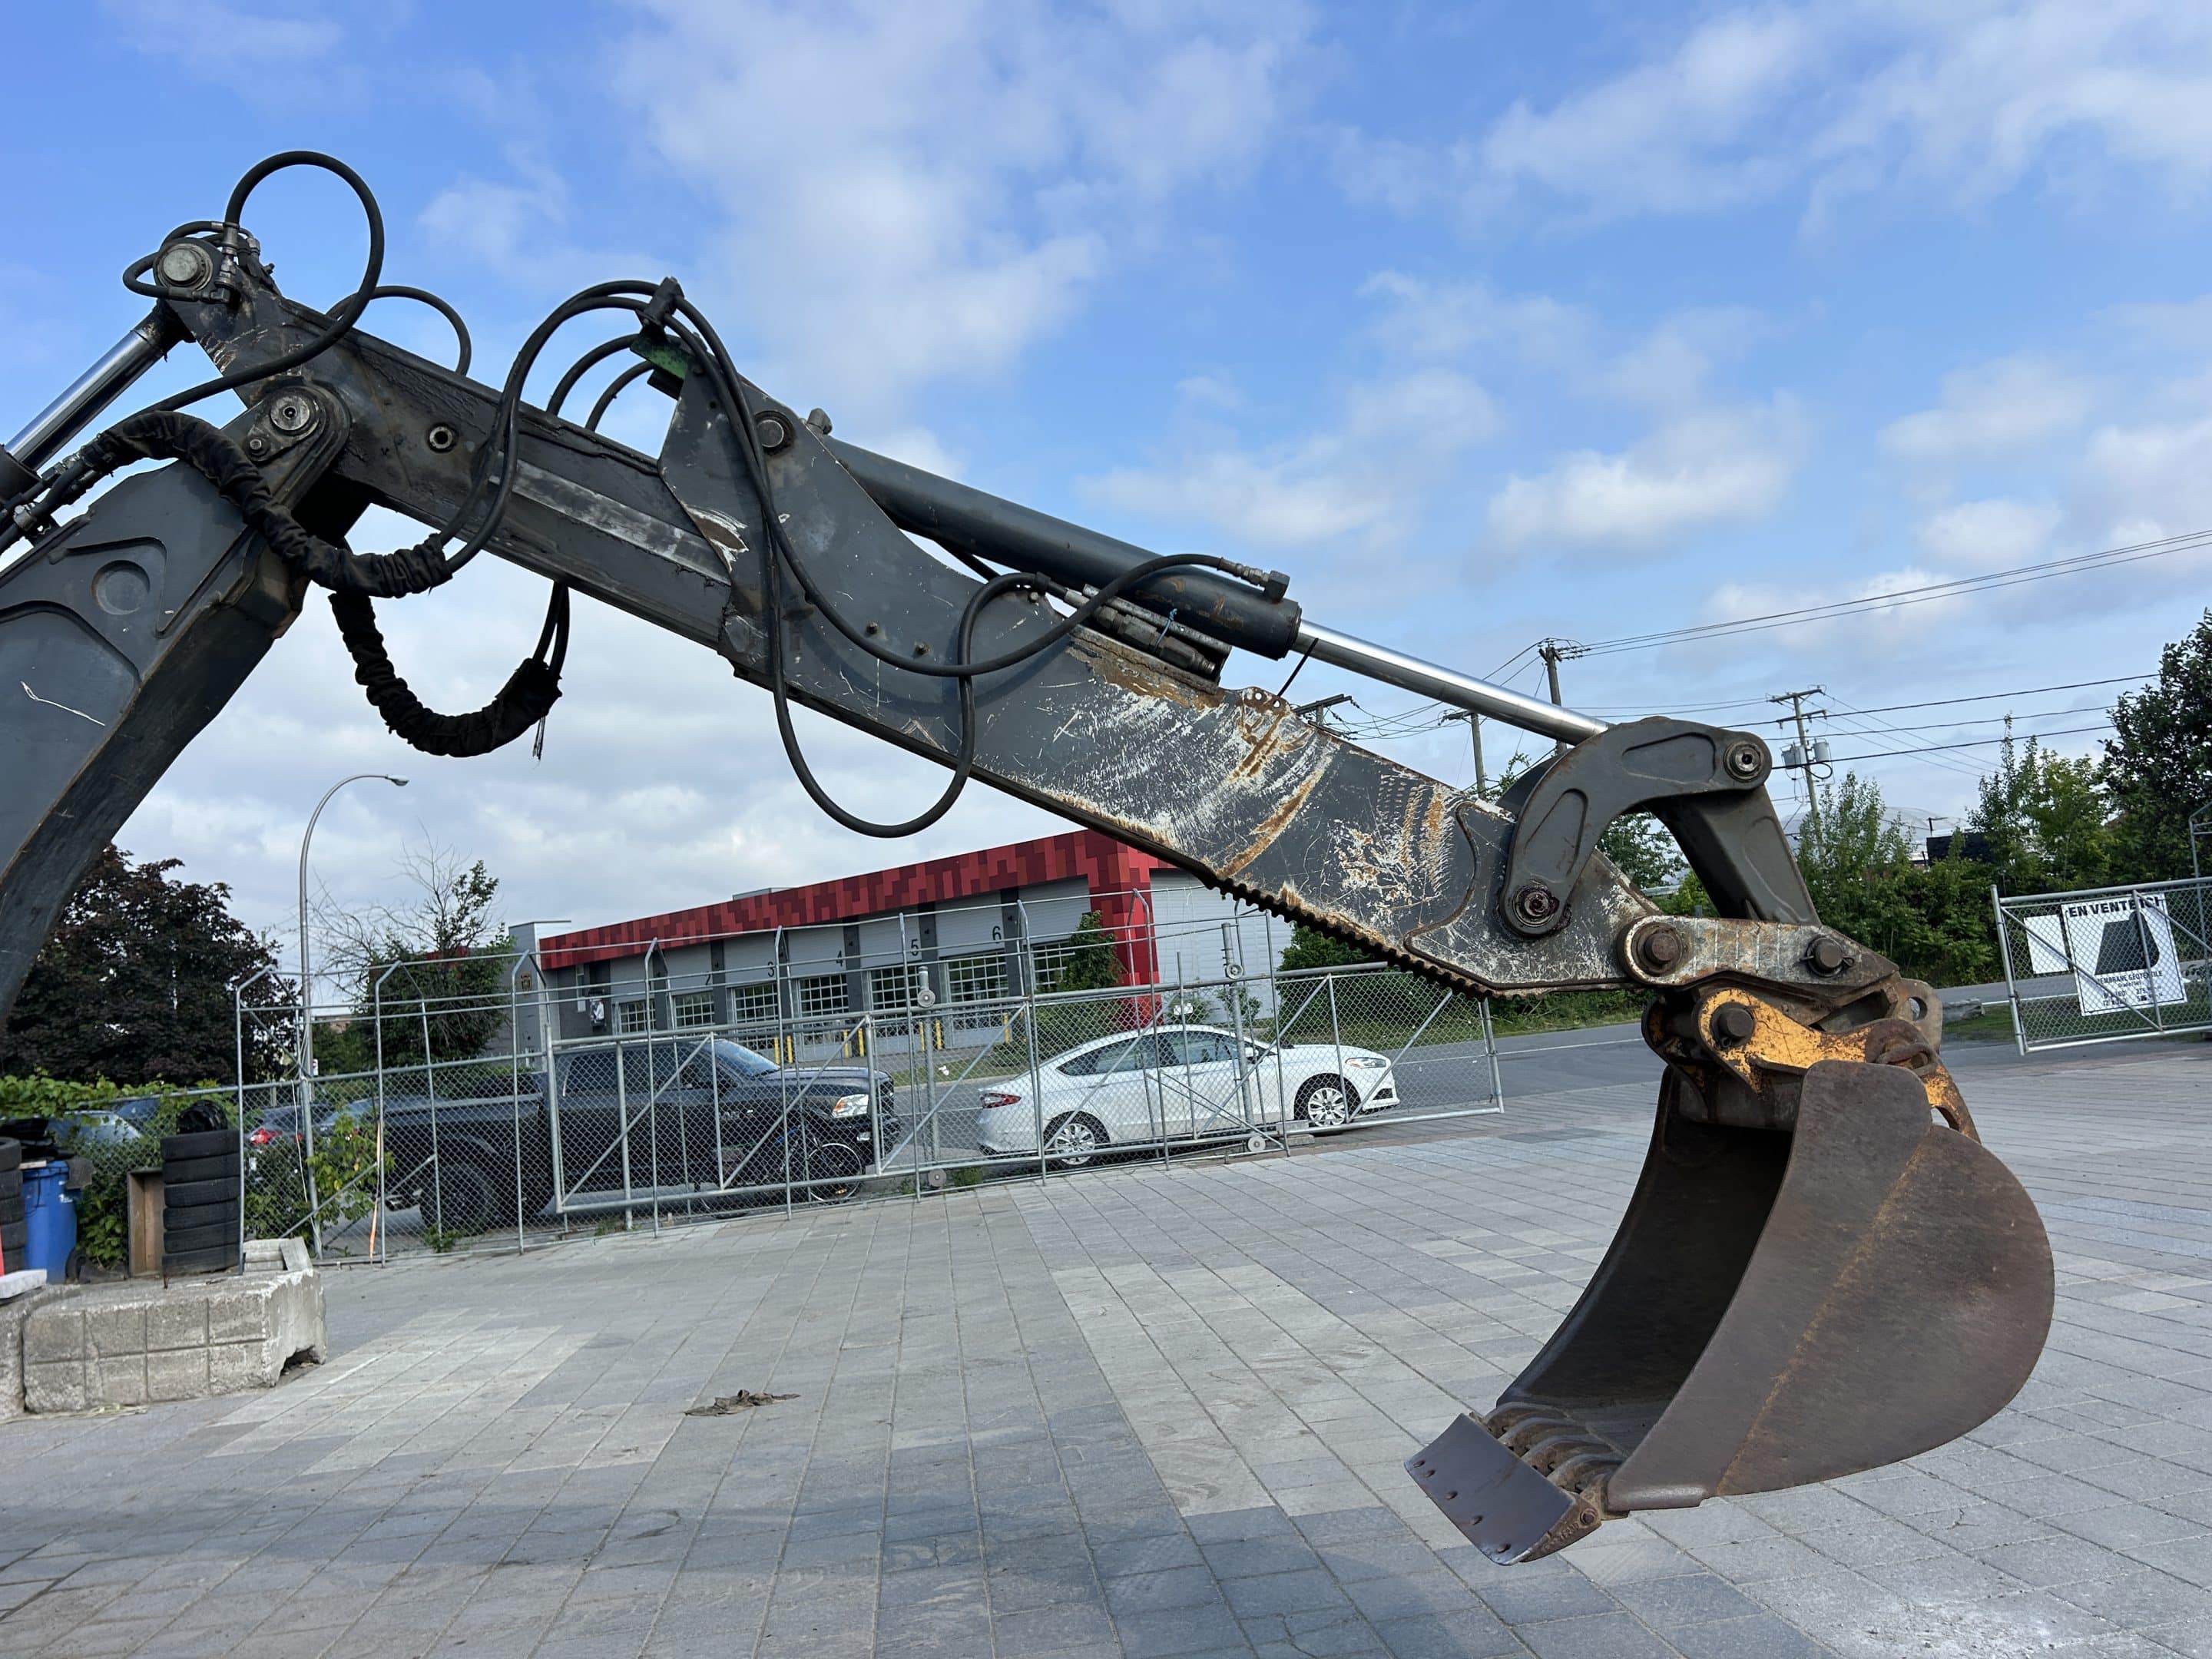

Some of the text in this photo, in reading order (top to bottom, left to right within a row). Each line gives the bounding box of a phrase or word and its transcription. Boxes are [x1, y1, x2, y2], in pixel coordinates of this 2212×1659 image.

[2068, 906, 2088, 917] EN
[2089, 899, 2135, 914] VENTE
[992, 926, 1002, 944] 6
[910, 939, 919, 956] 5
[836, 950, 843, 968] 4
[767, 961, 775, 978] 3
[2098, 974, 2128, 984] EMBRANE
